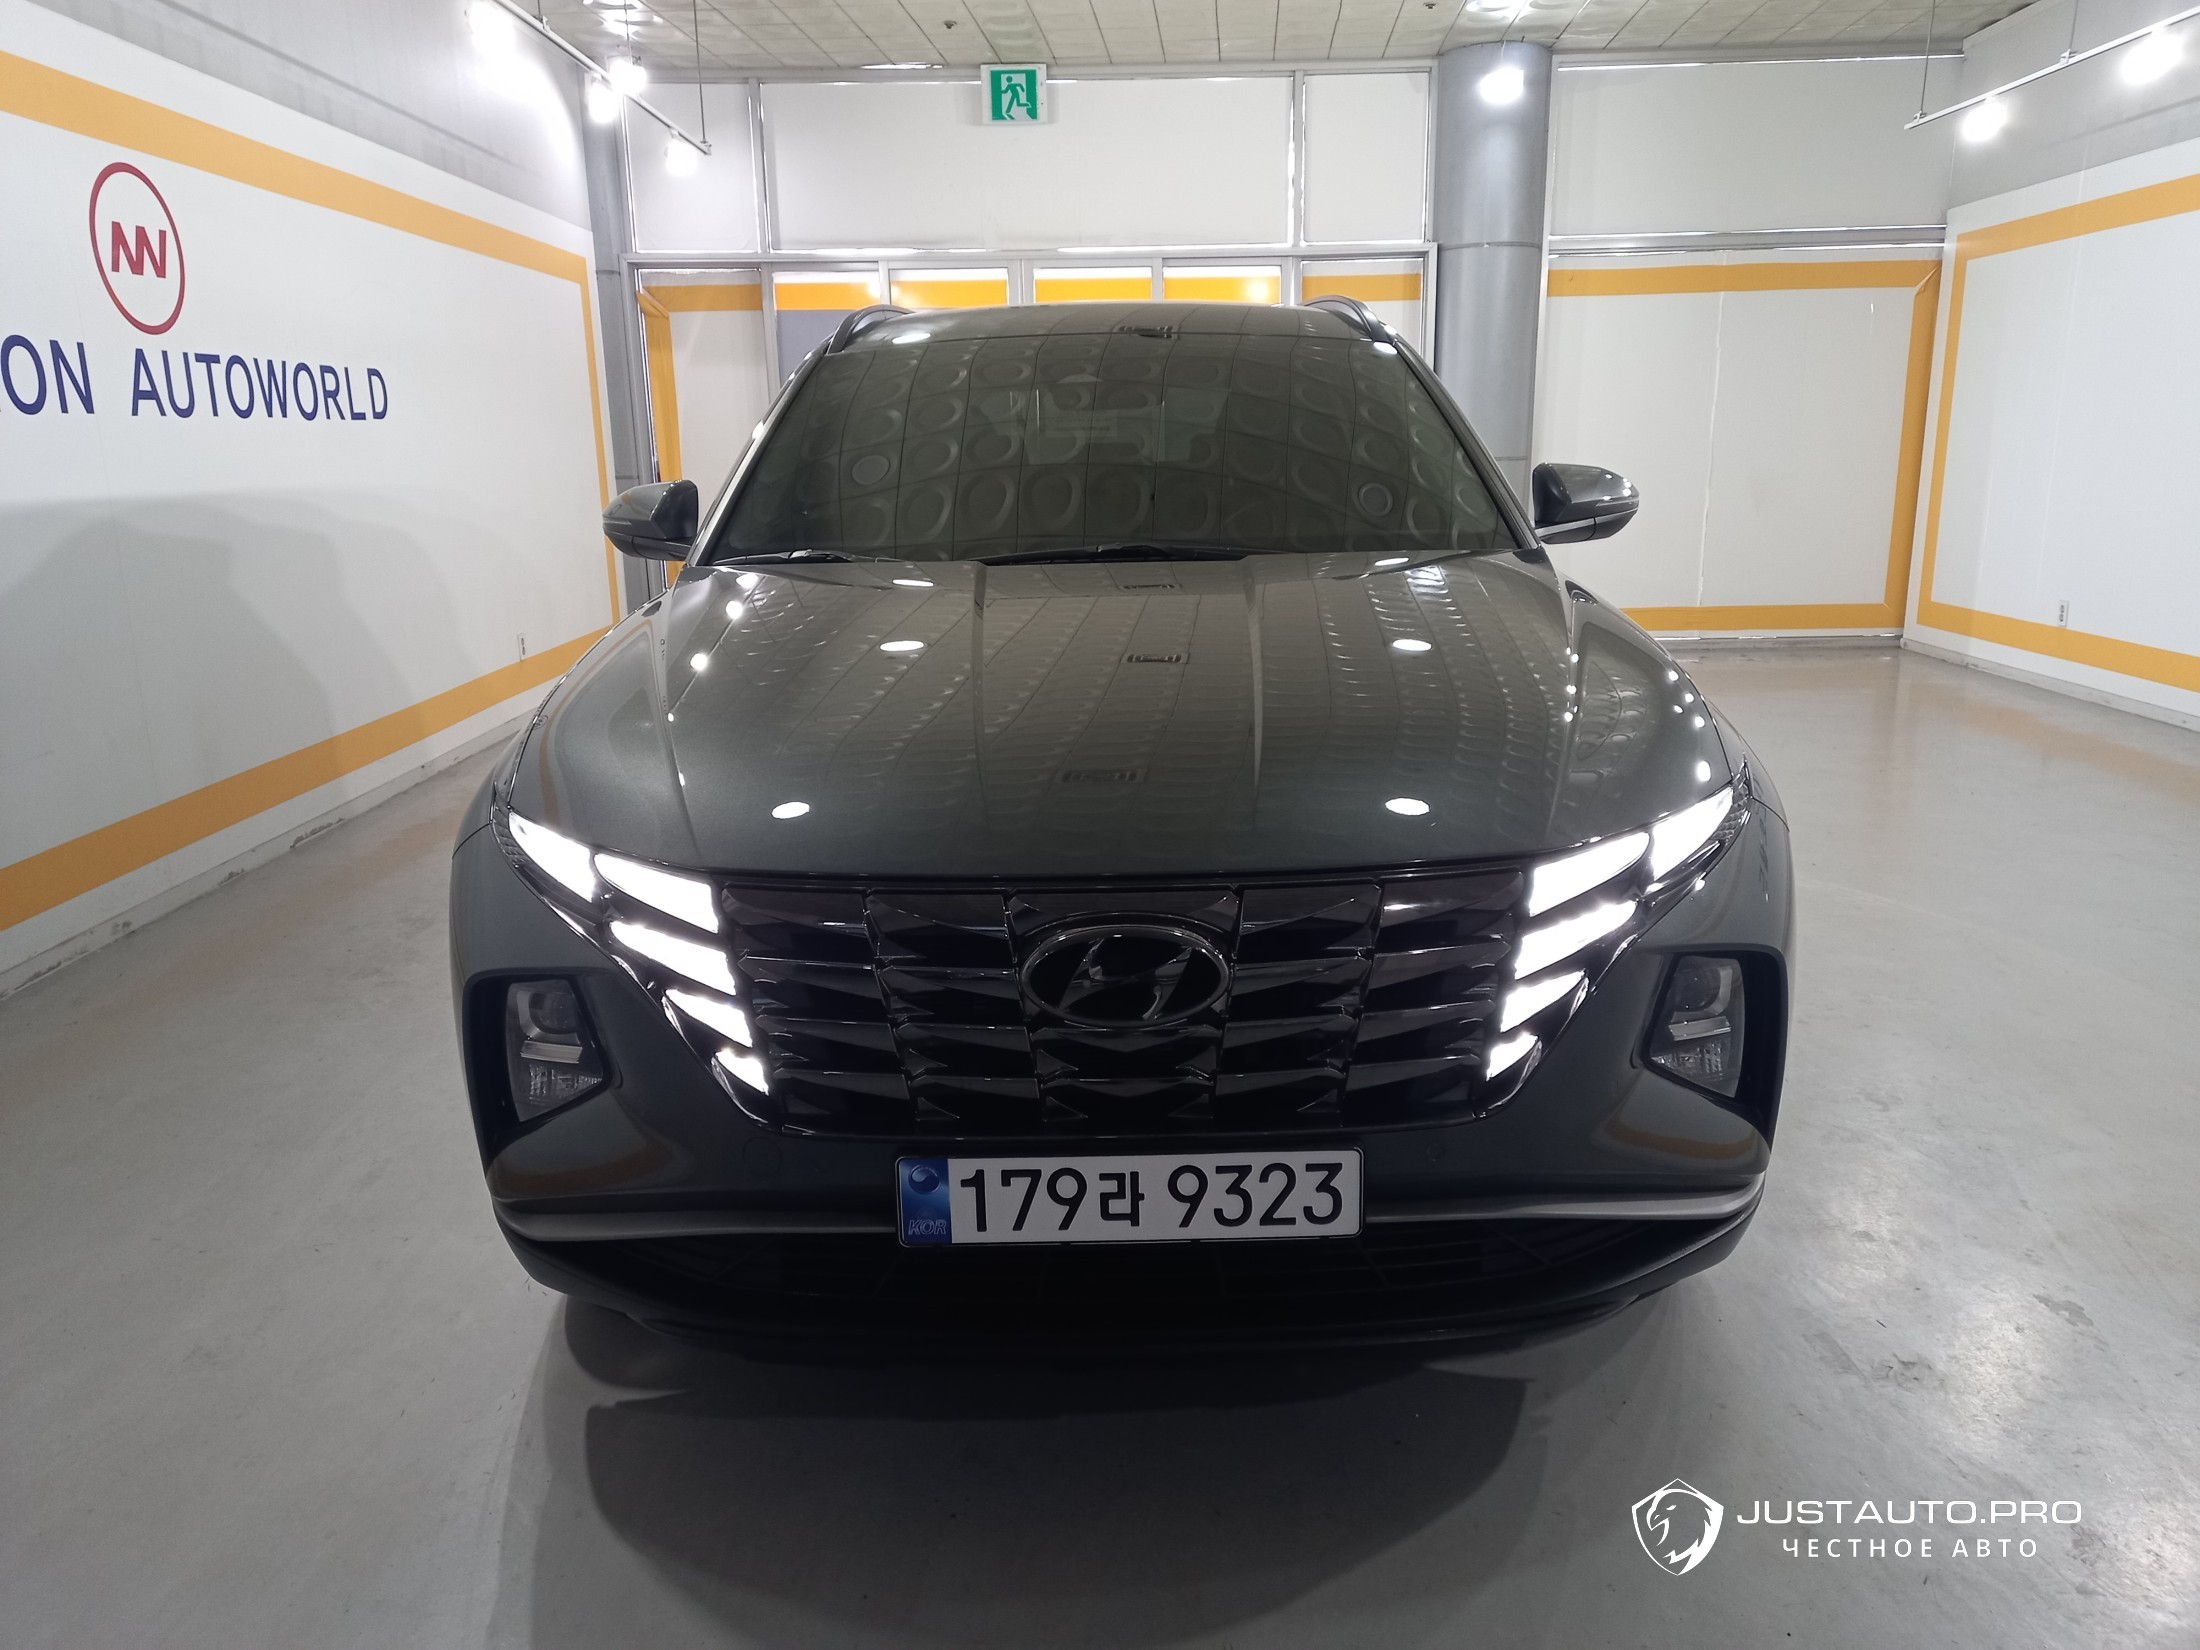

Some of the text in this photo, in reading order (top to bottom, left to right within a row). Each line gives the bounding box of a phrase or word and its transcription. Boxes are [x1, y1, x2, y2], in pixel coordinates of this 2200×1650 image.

[0, 334, 389, 421] ON AUTOWORLD
[908, 1219, 947, 1235] KOR
[960, 1162, 1343, 1233] 179라 9323
